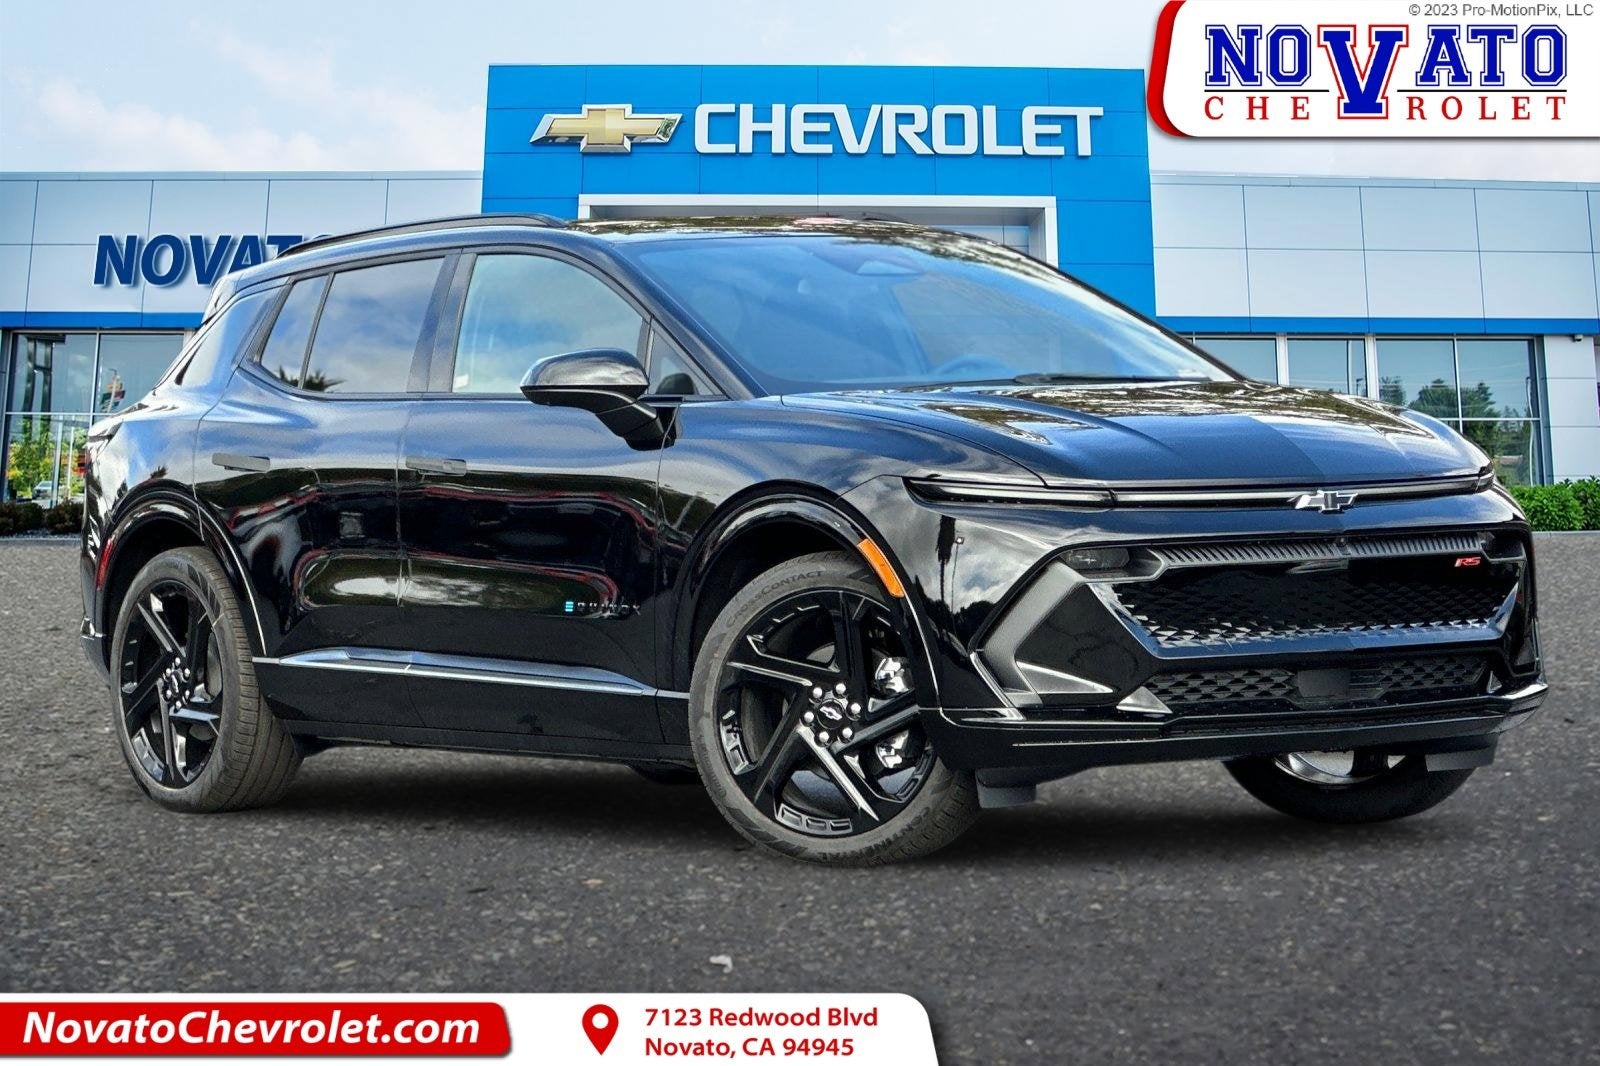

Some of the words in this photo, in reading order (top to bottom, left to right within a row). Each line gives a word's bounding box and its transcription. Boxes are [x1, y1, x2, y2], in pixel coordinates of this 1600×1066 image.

[694, 103, 1104, 157] CHEVROLET
[93, 234, 338, 286] NOVA
[1454, 556, 1481, 568] RS
